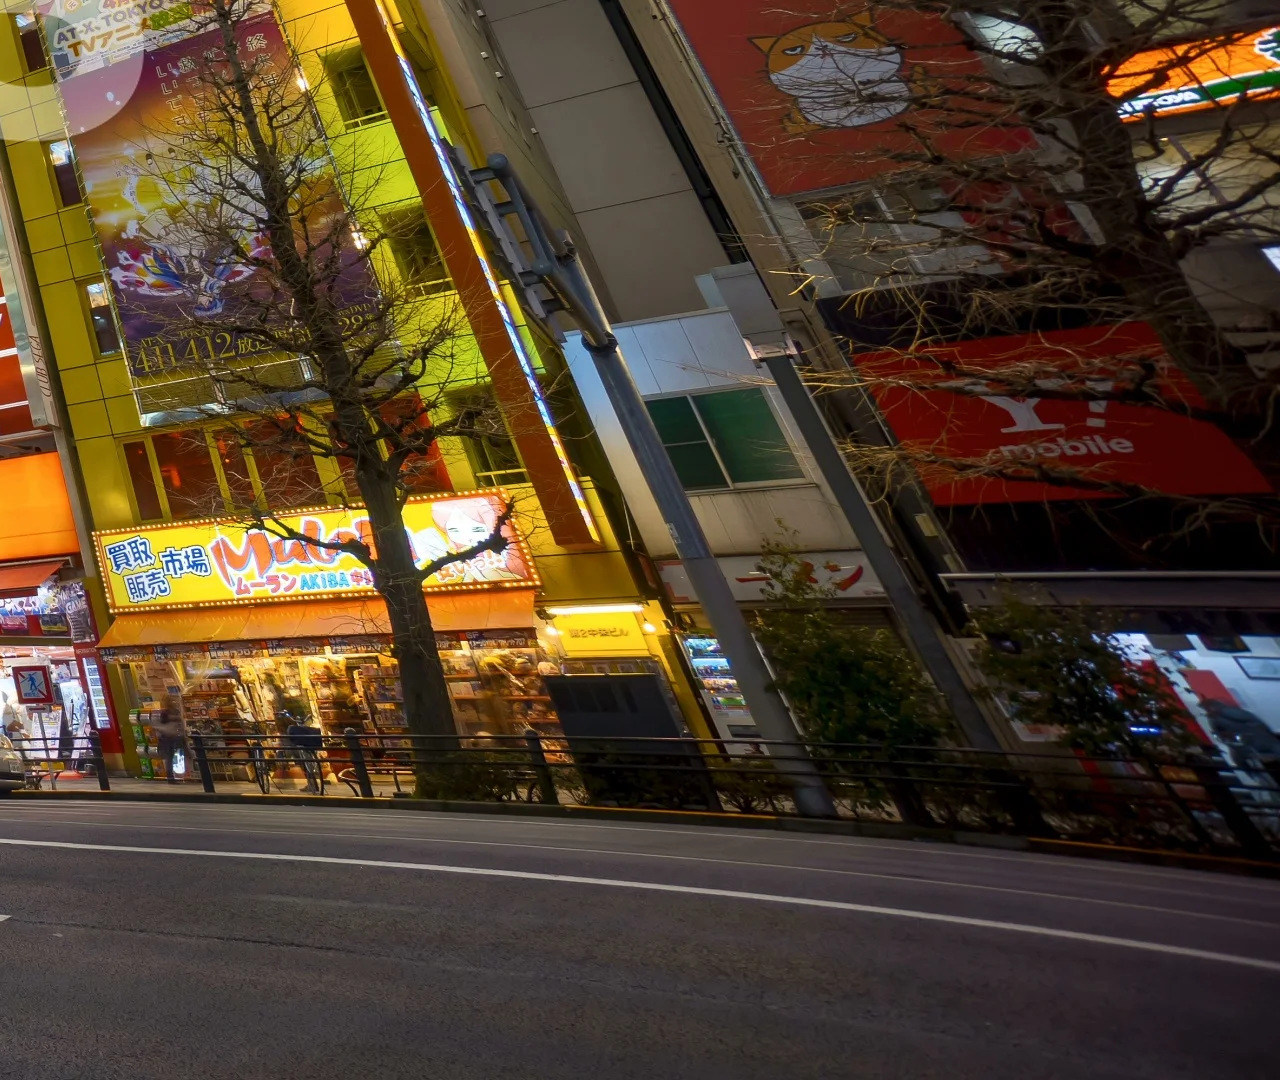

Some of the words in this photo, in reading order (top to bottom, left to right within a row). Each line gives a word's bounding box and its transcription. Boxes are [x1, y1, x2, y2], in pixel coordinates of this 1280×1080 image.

[107, 537, 154, 572] 買取
[161, 549, 210, 576] 市場
[126, 570, 169, 600] 販売
[235, 573, 297, 597] ムーラン
[299, 571, 351, 591] AKIBA
